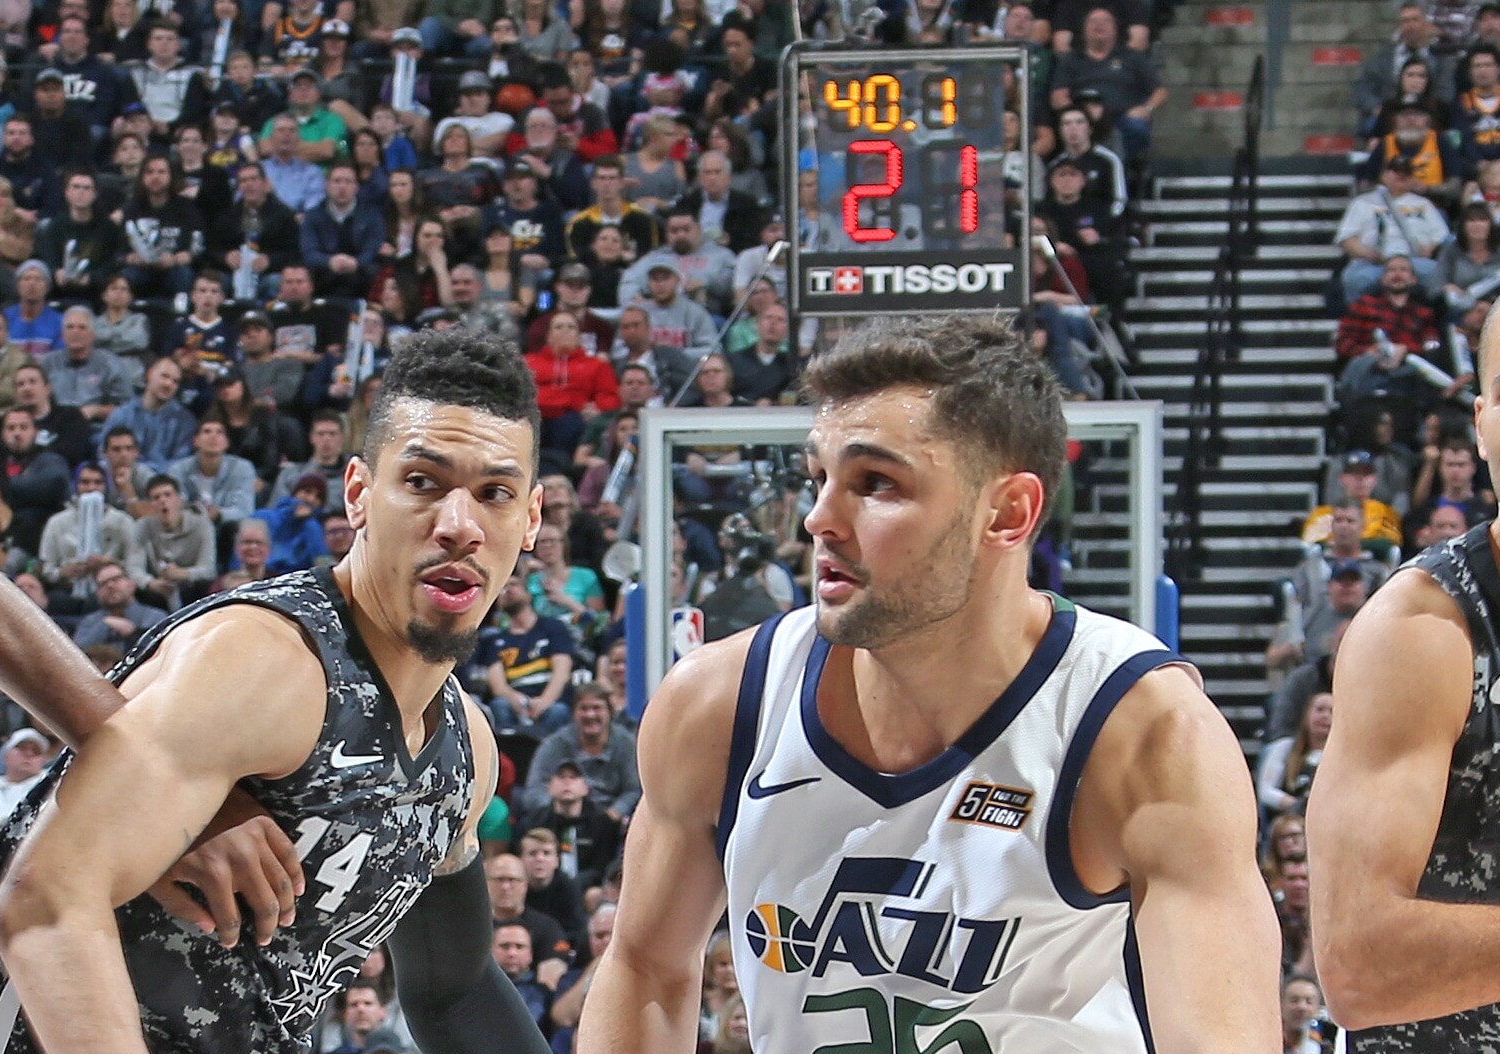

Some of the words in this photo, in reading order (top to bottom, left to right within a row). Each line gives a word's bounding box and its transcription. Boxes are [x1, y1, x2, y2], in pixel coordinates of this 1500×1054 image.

[824, 73, 957, 132] 40.1
[842, 139, 979, 242] 21
[863, 263, 1014, 294] TISSOT
[958, 787, 988, 818] 5
[981, 806, 1025, 827] FIGHT
[295, 815, 375, 913] 14
